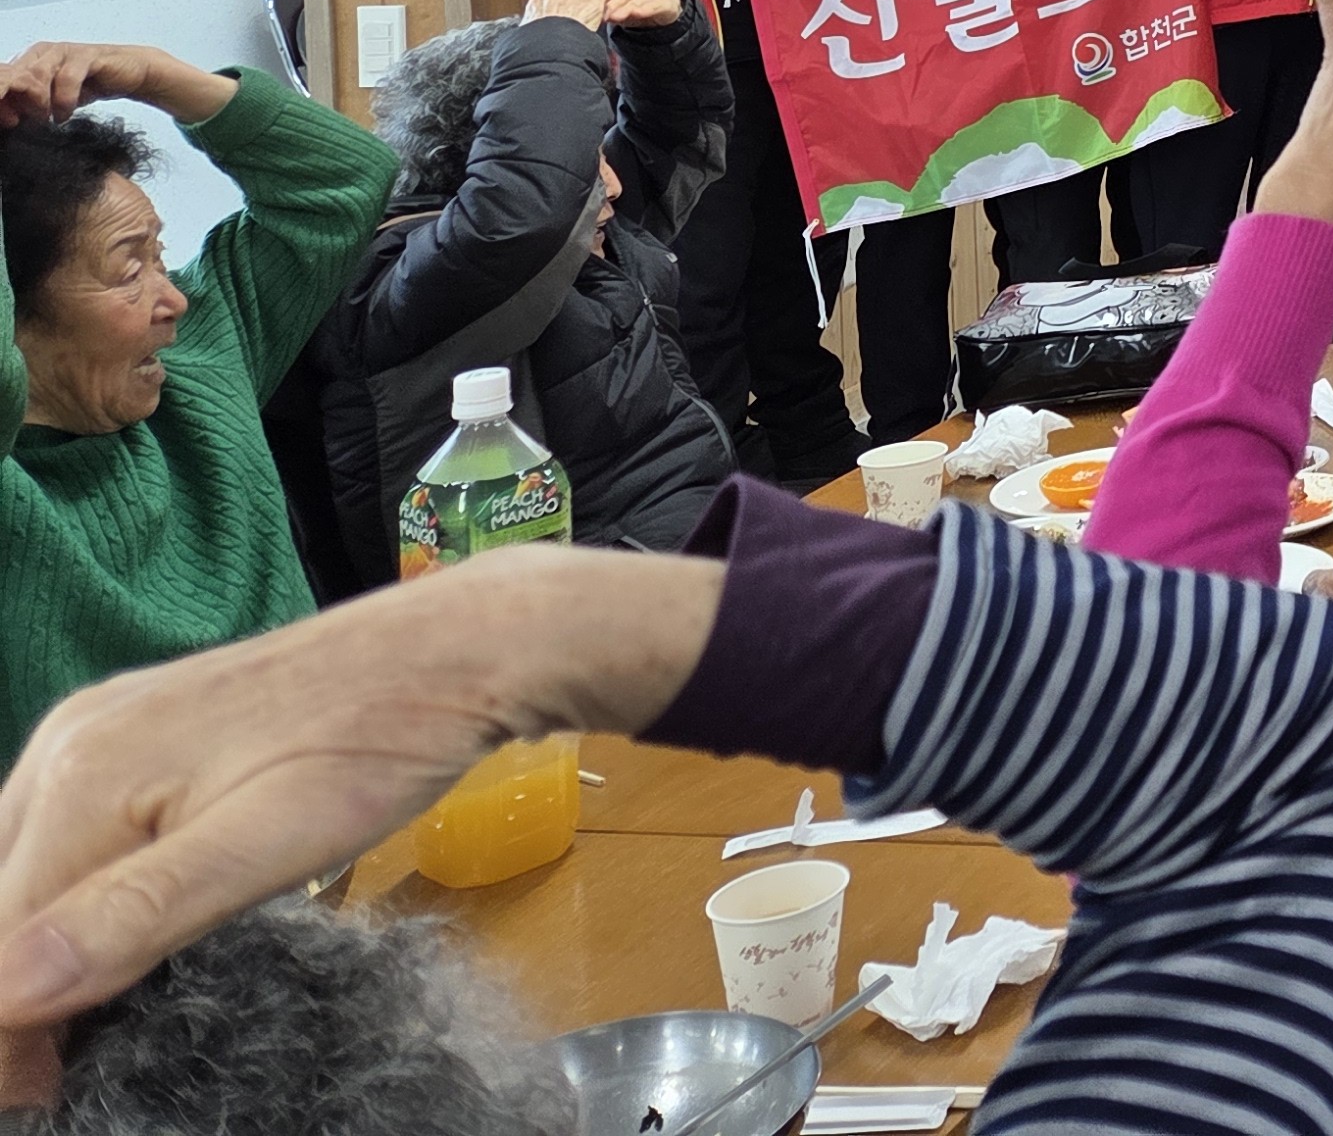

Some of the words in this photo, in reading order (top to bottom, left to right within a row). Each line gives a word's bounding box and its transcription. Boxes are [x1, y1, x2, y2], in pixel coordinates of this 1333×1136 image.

[1119, 4, 1198, 62] 합천군
[490, 498, 559, 531] MANGO
[491, 486, 545, 514] PEACH
